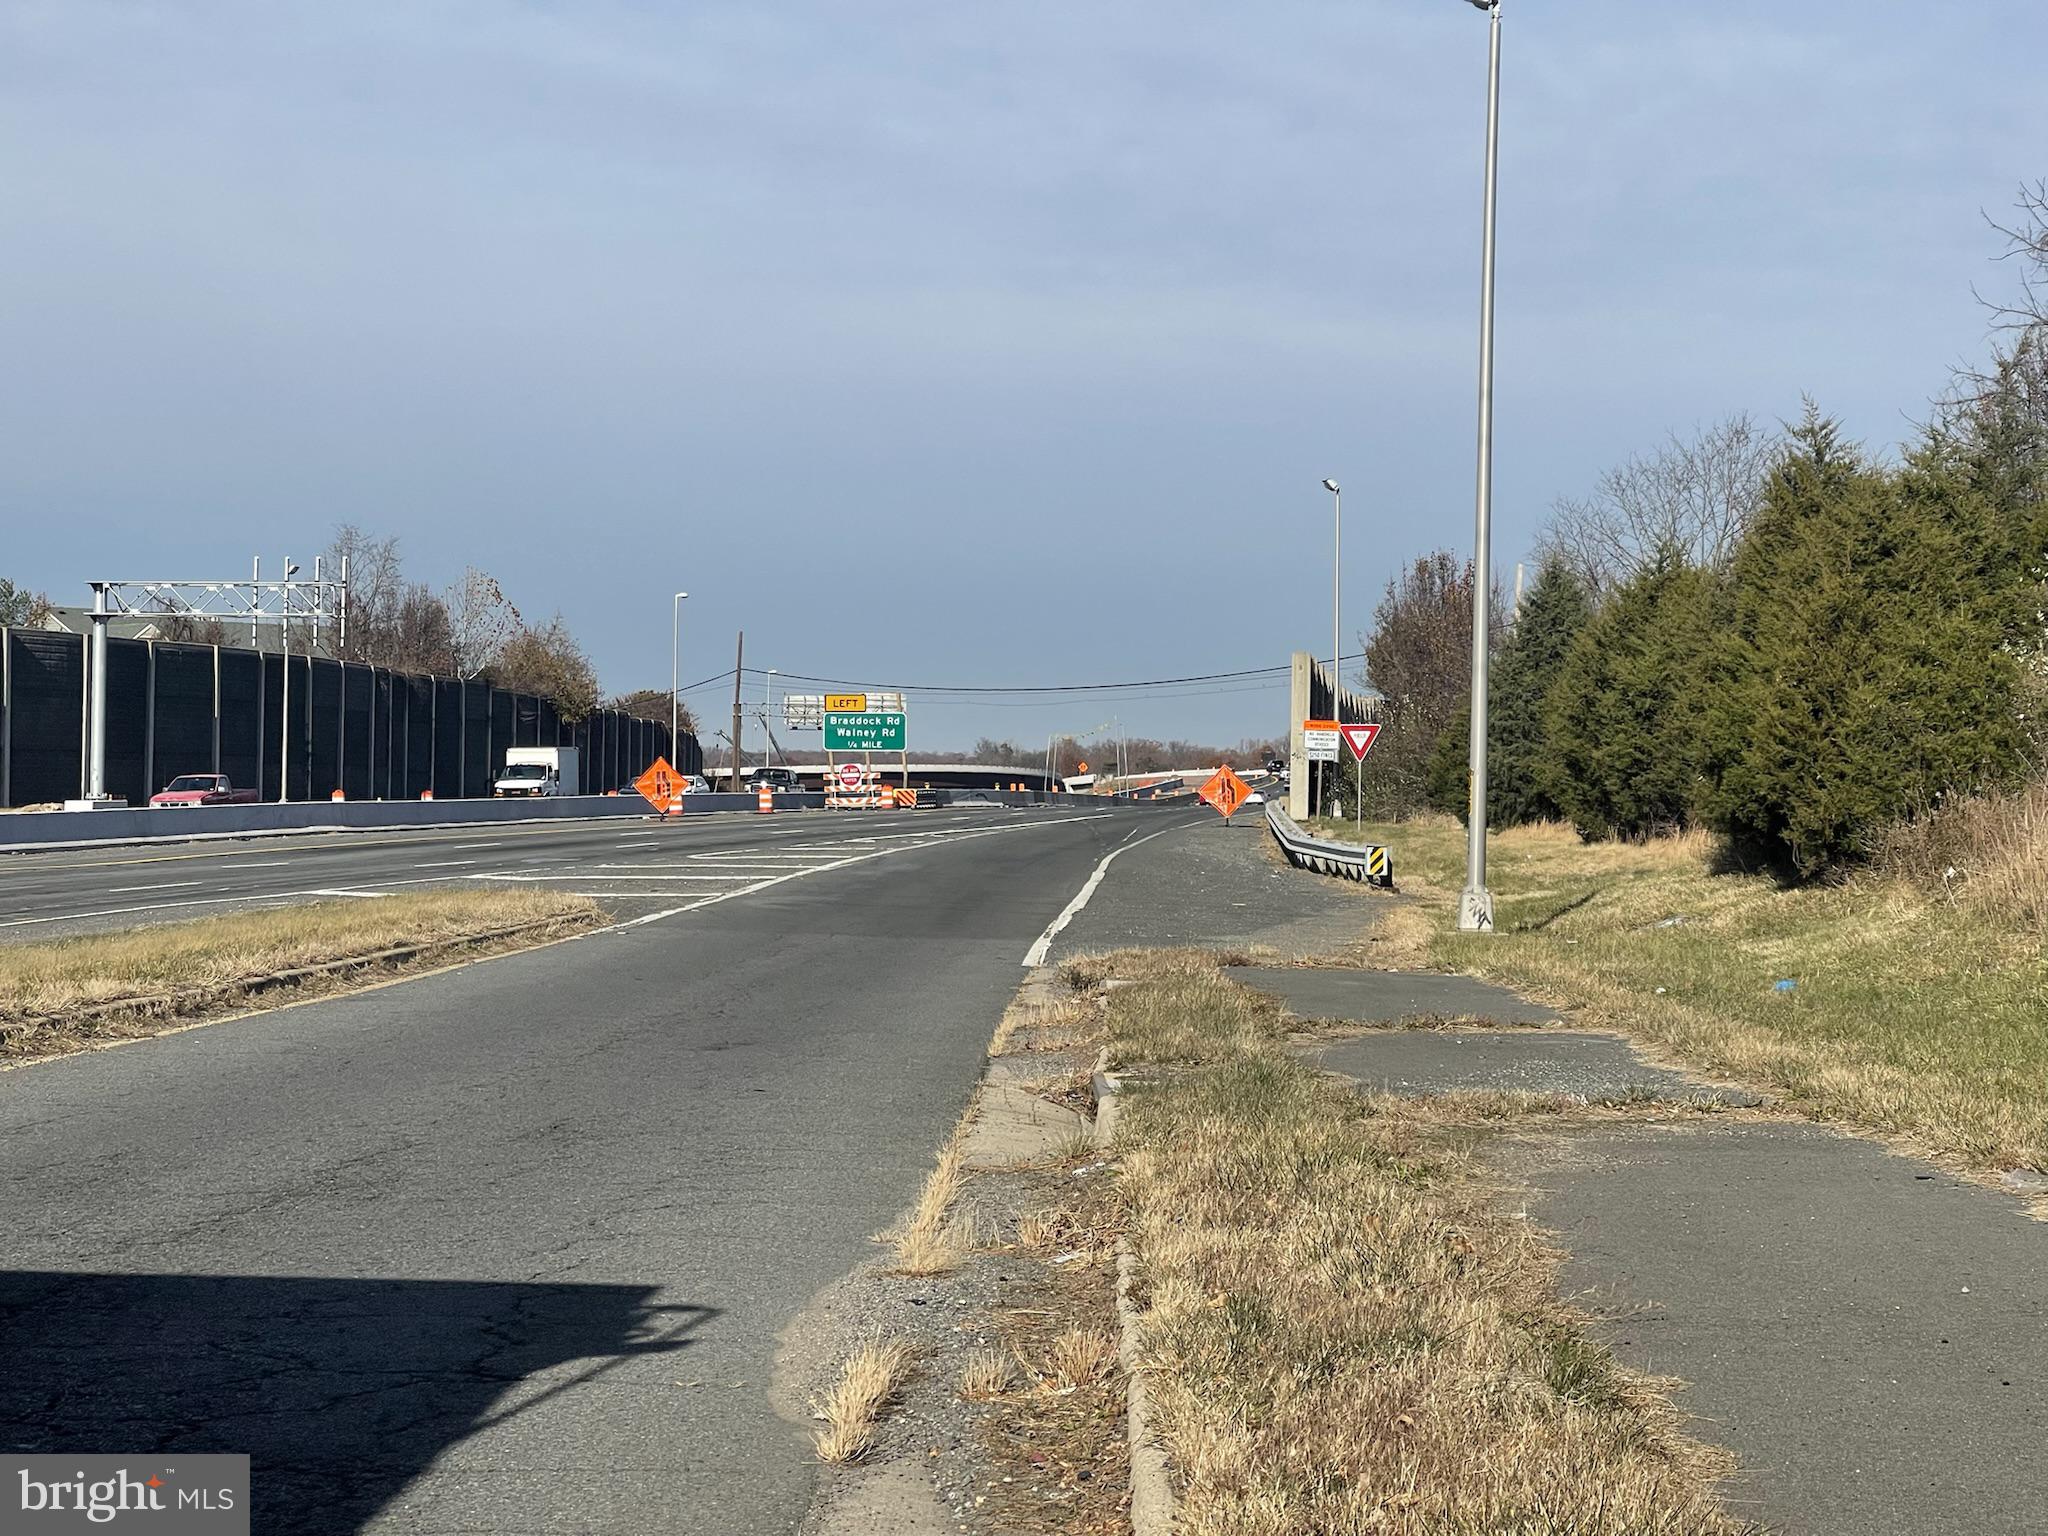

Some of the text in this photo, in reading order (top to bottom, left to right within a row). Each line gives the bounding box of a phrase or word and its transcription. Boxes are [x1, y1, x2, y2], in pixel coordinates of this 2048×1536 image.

[833, 699, 858, 708] LEFT
[830, 716, 900, 725] Braddock Rd
[882, 728, 896, 737] Rd
[861, 741, 883, 749] MILE
